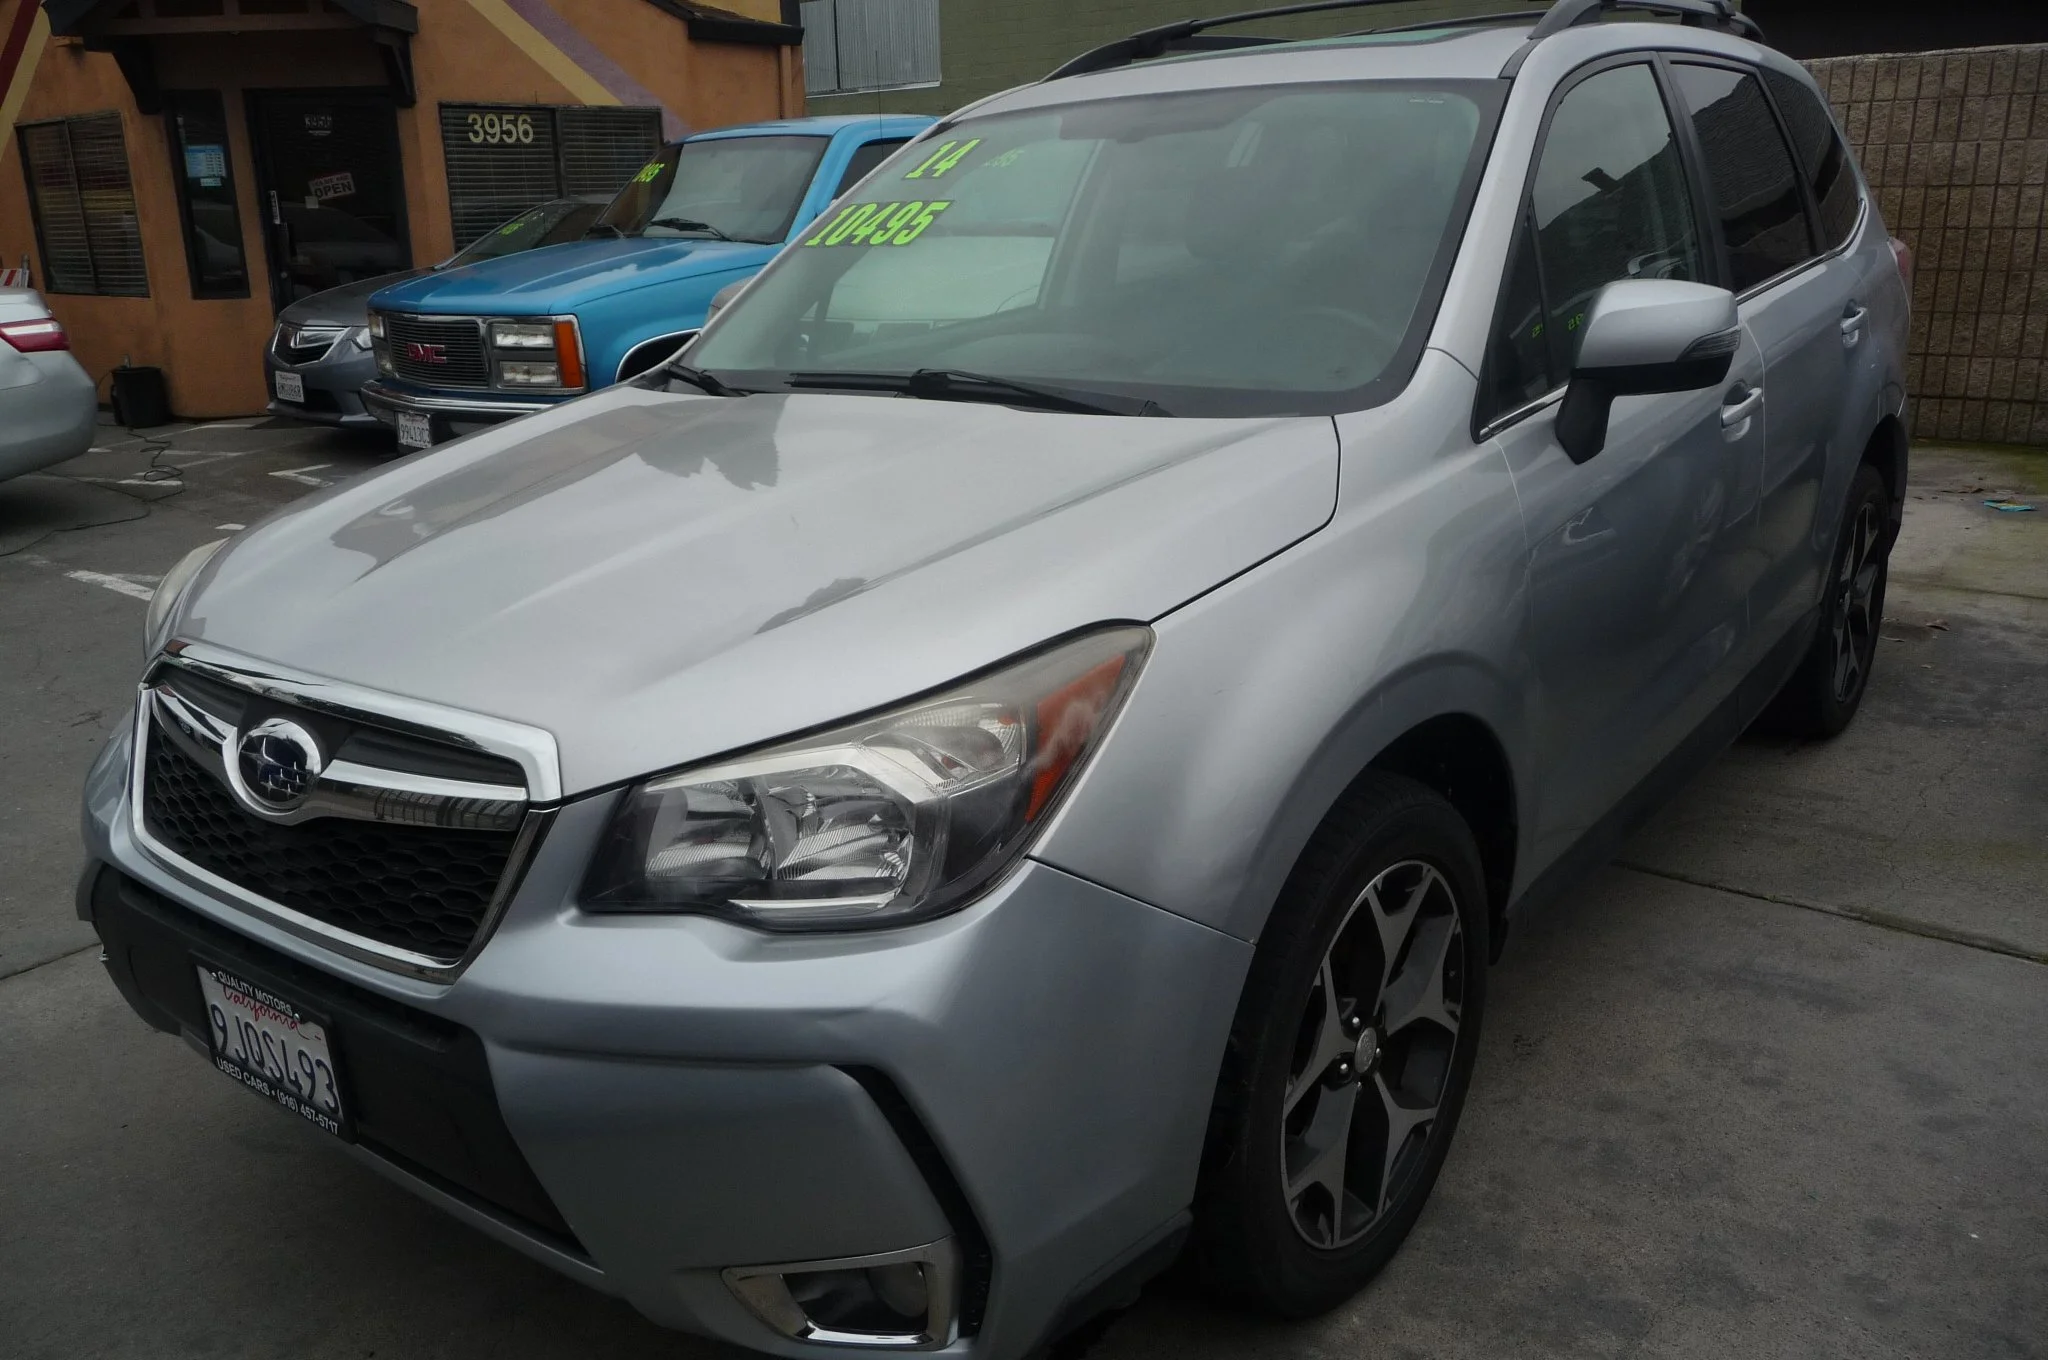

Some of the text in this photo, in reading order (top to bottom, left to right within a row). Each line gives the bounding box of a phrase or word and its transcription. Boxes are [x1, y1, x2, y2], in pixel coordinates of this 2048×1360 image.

[467, 113, 534, 144] 3956
[905, 139, 981, 178] 14
[315, 181, 352, 199] OPEN
[804, 201, 951, 246] 10495
[407, 343, 448, 364] GMC
[218, 971, 293, 1017] QUALITY MOTORS
[223, 985, 309, 1041] California
[216, 1056, 242, 1080] USED
[243, 1072, 271, 1096] CARS
[300, 1105, 339, 1135] 457-5717
